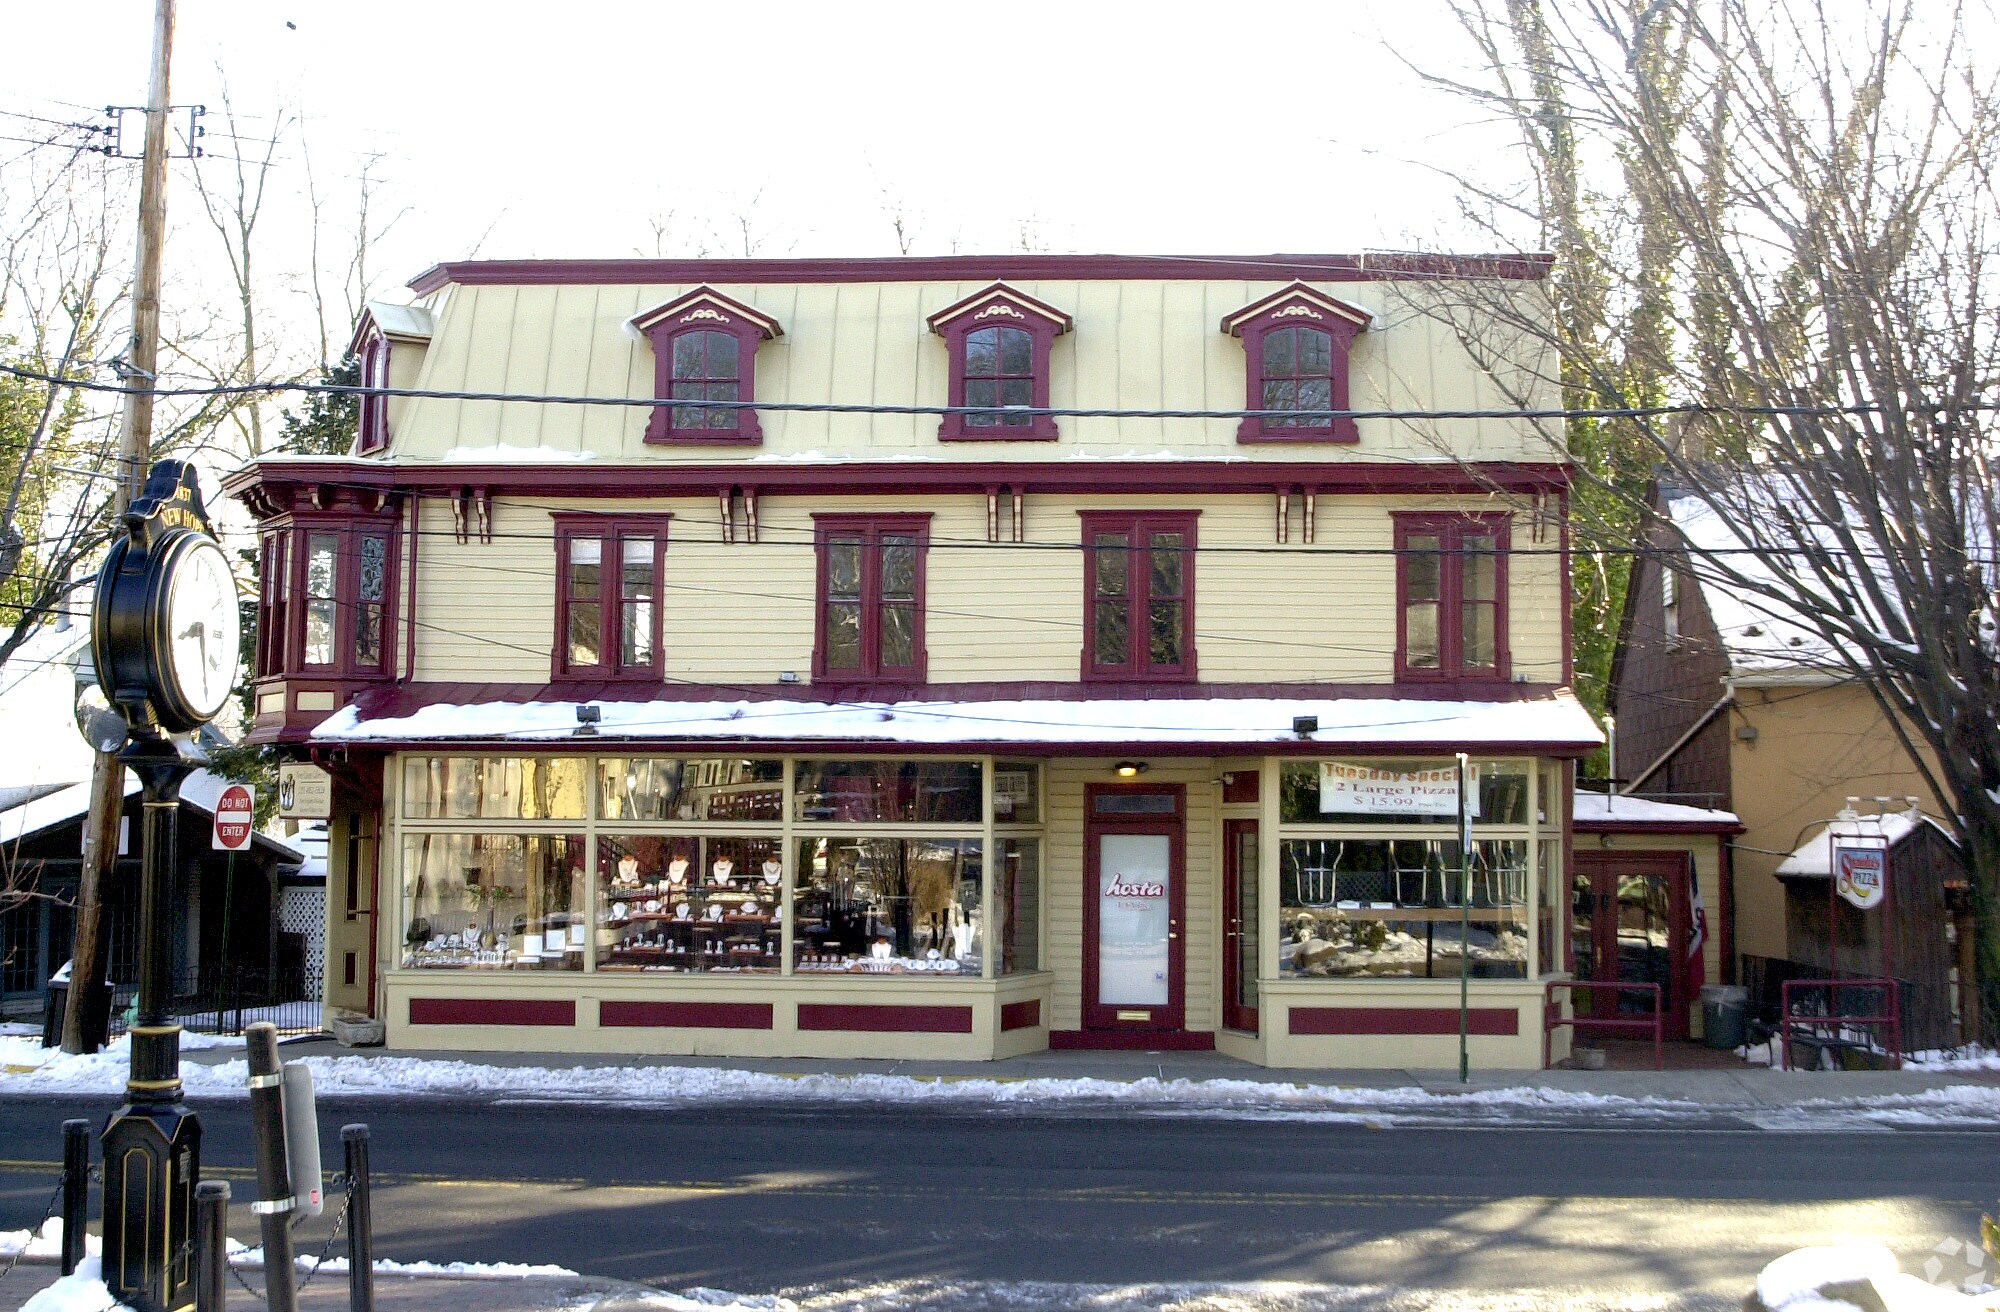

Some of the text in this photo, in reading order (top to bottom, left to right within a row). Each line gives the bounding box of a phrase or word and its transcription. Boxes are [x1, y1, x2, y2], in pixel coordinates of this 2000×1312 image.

[160, 507, 181, 529] NEW
[1325, 763, 1400, 782] Tuesday
[1336, 782, 1456, 796] 2 Large Pizza
[222, 797, 249, 809] DO NOT
[222, 825, 244, 837] ENTER
[1105, 873, 1164, 897] hosta
